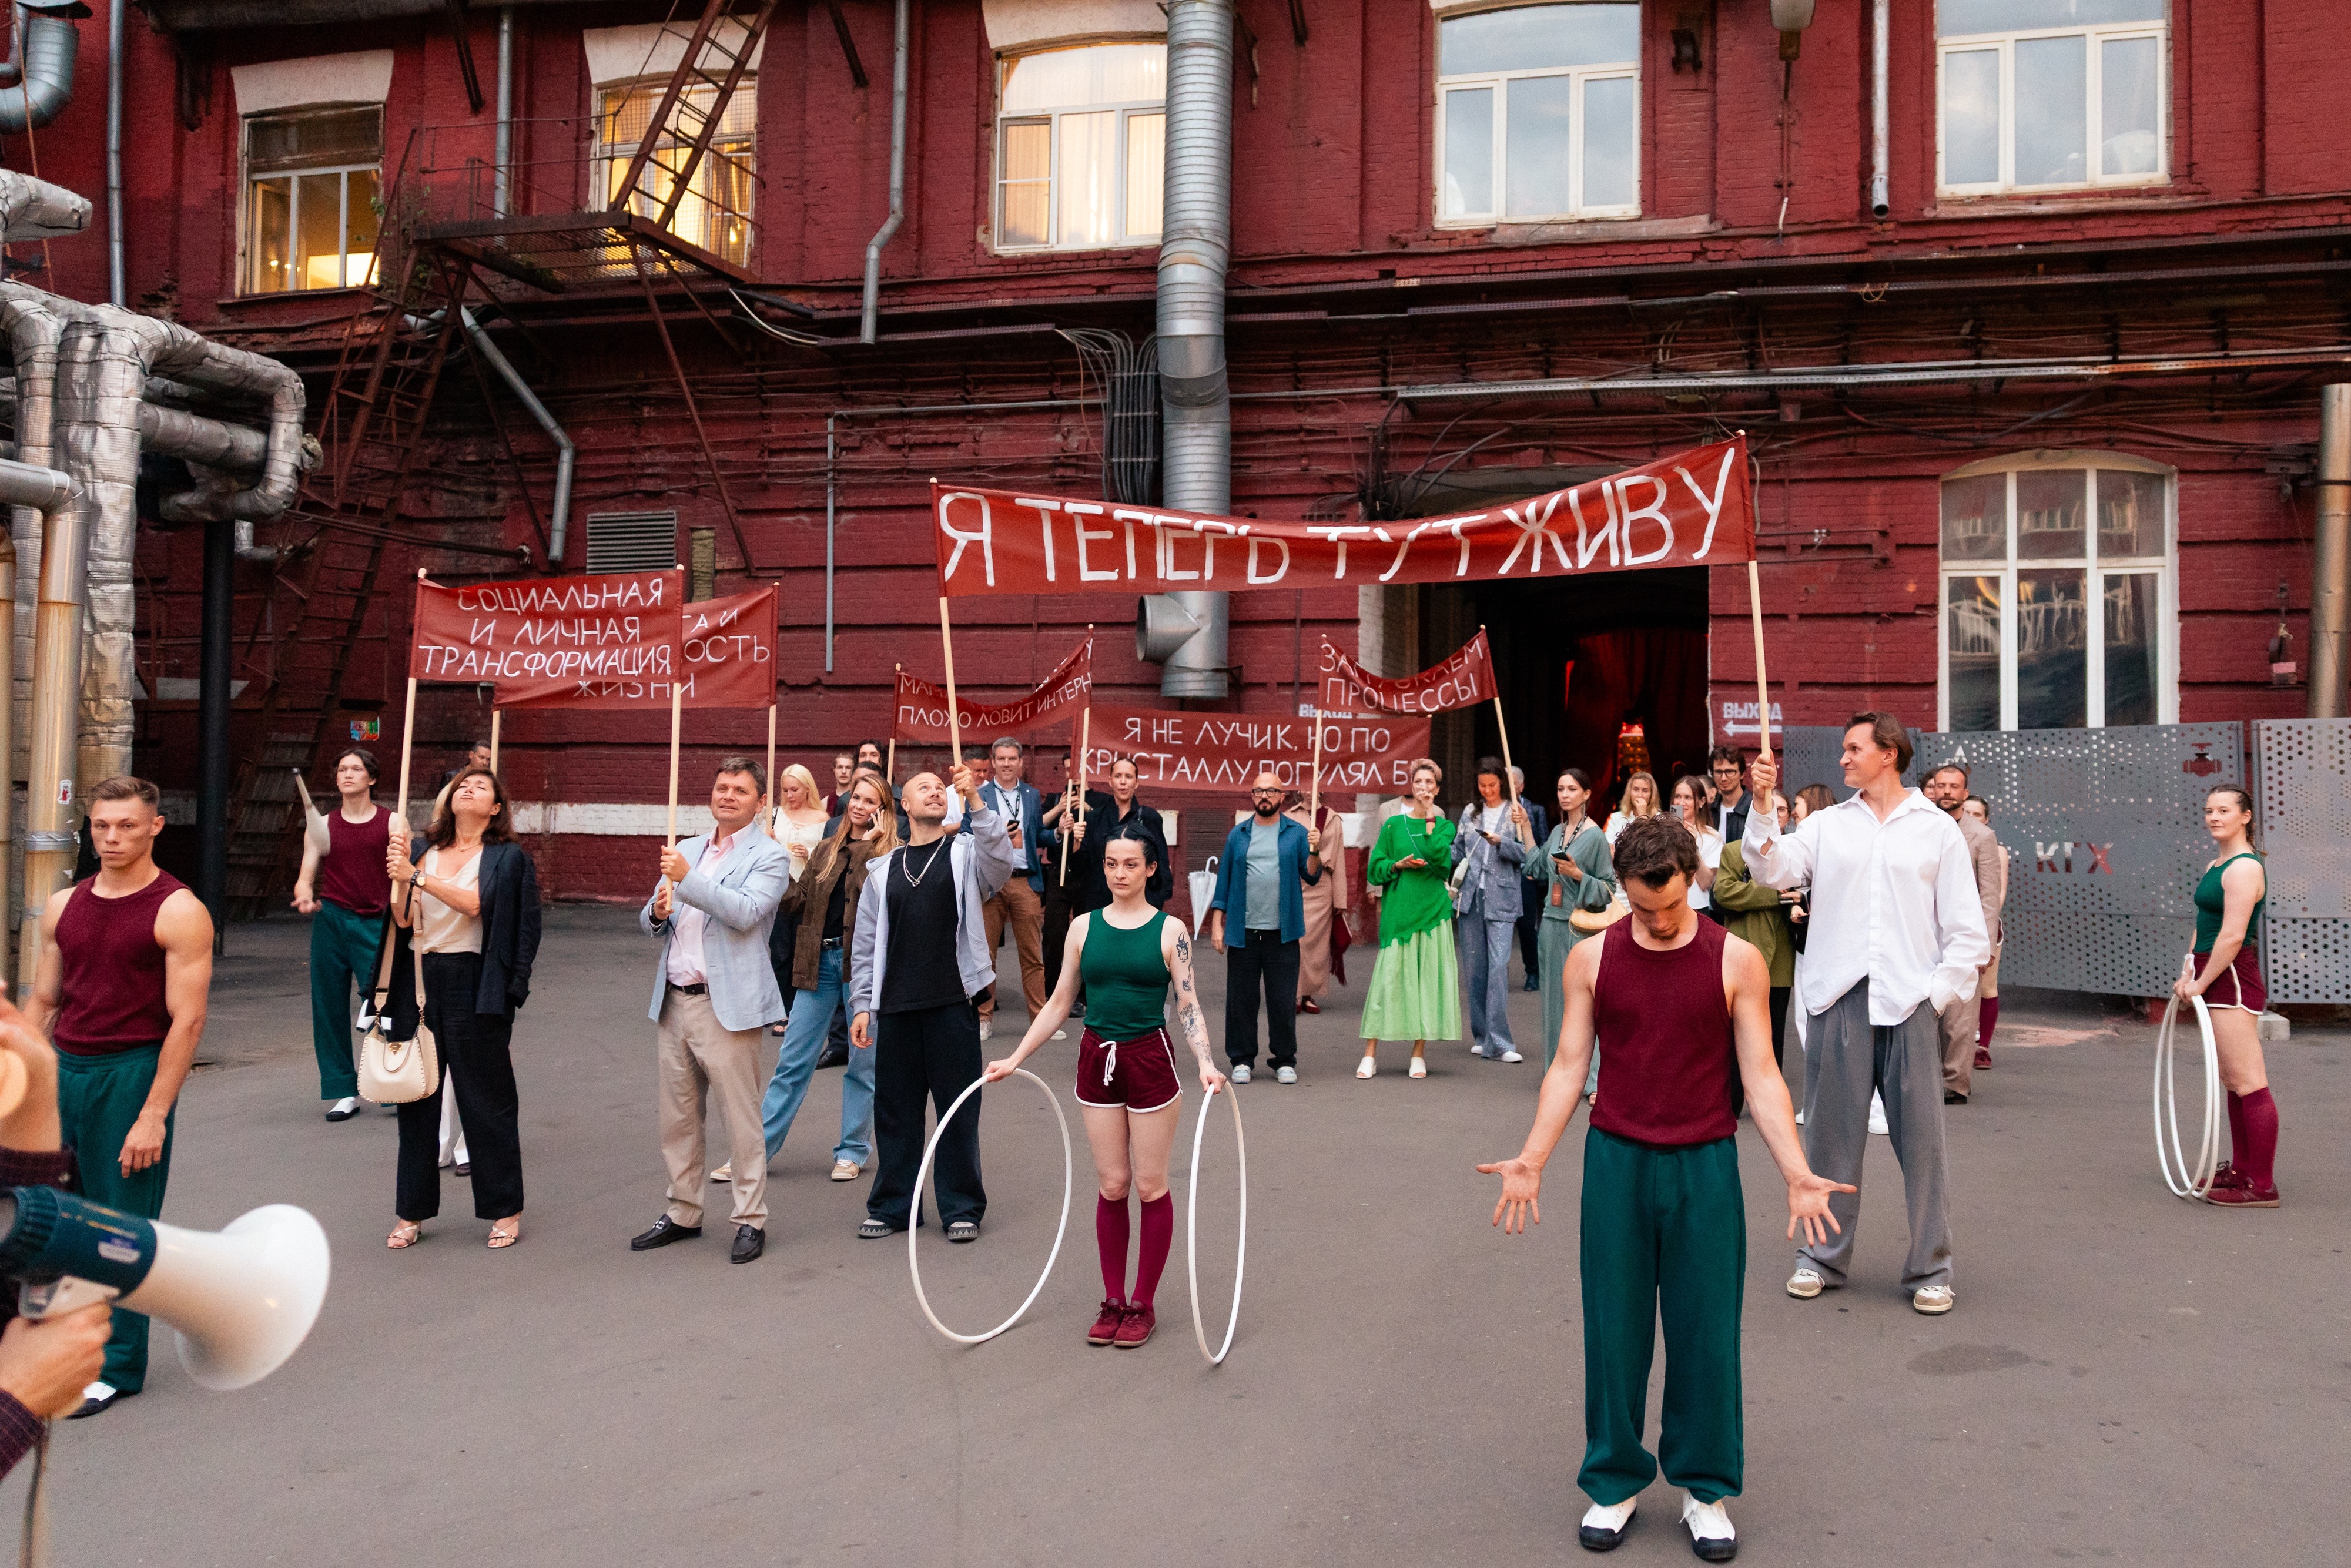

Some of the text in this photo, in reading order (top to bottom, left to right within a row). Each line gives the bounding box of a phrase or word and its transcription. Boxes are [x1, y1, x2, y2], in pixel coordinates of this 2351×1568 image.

[940, 448, 1734, 586] Я ТЕПЕРЬ ТУТ ЖИВУ
[458, 578, 662, 615] СОЦИАЛЬНАЯ
[471, 617, 639, 645] И ЛИЧНАЯ
[719, 608, 739, 627] И
[419, 645, 671, 677] ТРАНСФОРМАЦИЯ
[1327, 672, 1477, 712] ПРОЦЕССЫ
[899, 705, 972, 728] ПЛОХО
[977, 701, 1033, 728] ЛОВИТ
[1723, 702, 1783, 721] ВЫХД
[1124, 718, 1391, 752] Я НЕ ЛУЧИК, НО ПО
